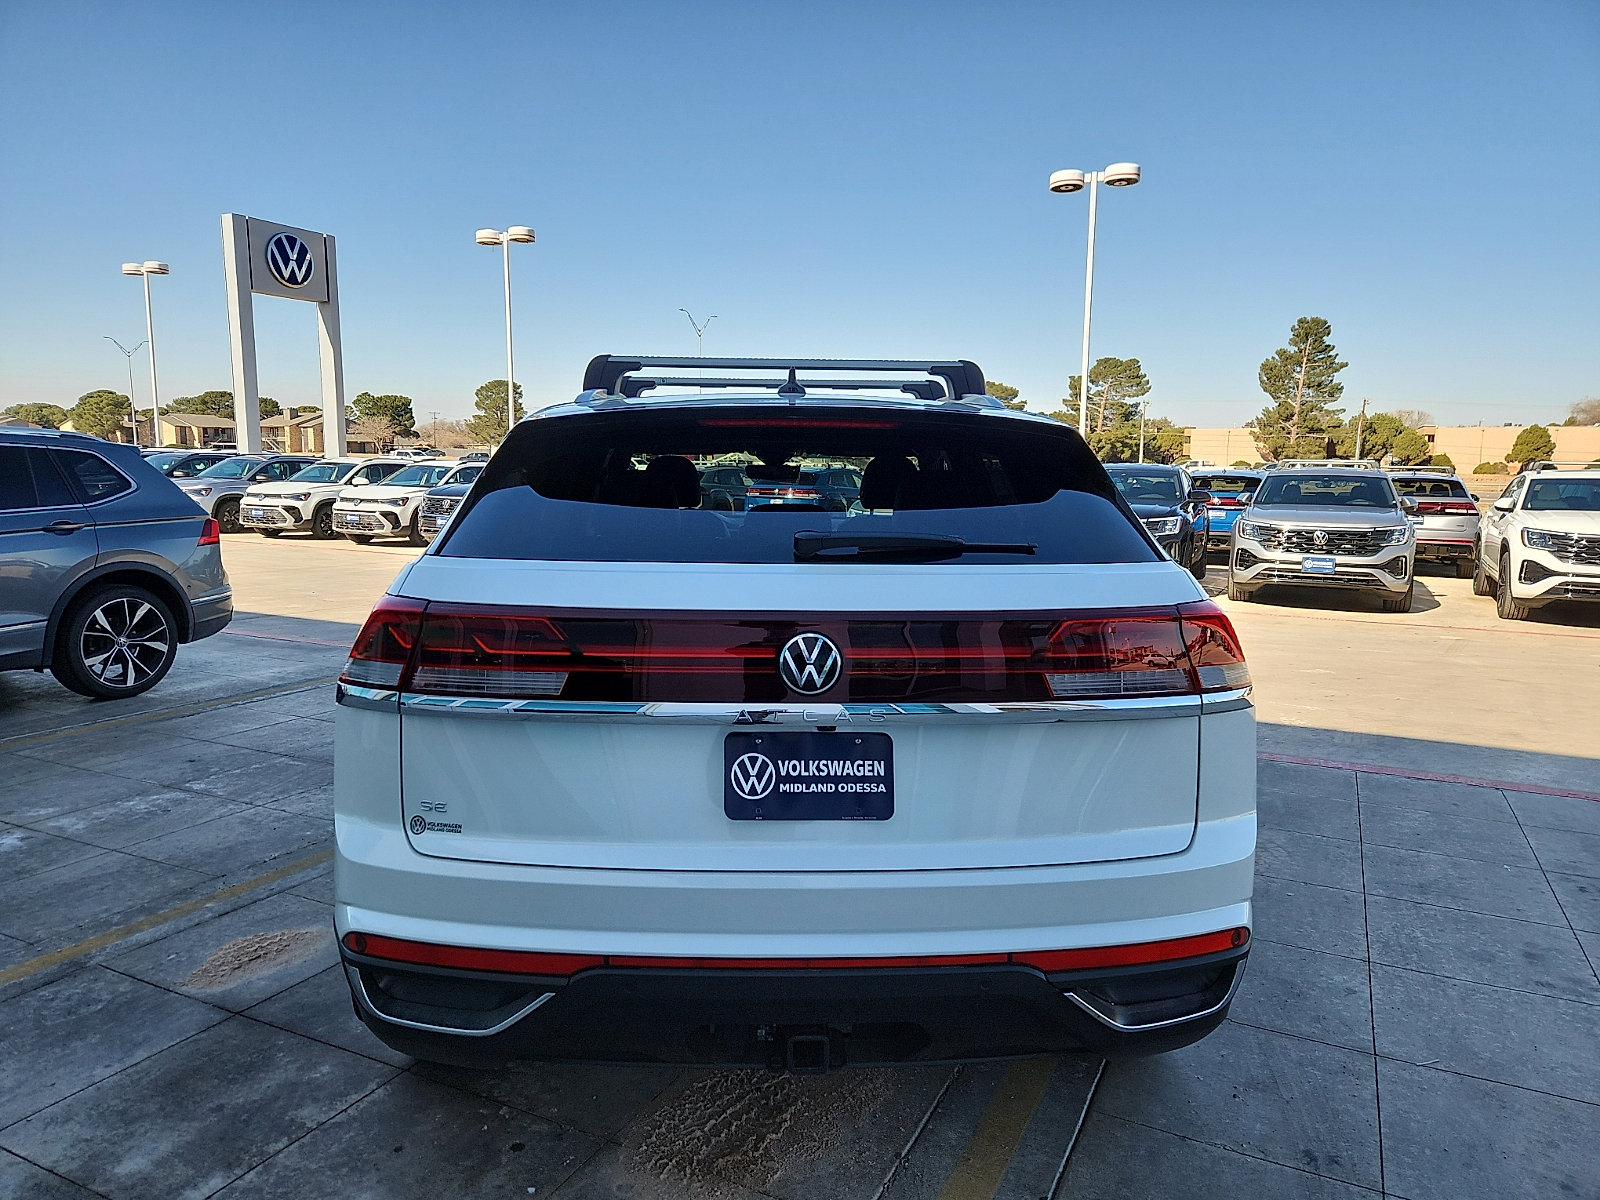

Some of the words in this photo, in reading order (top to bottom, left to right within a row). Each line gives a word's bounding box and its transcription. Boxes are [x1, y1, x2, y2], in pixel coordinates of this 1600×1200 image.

[267, 232, 314, 289] VW
[779, 632, 842, 695] VW
[734, 708, 886, 723] ATLAS
[731, 752, 776, 800] VW
[777, 759, 885, 777] VOLKSWAGEN
[779, 783, 835, 793] MIDLAND
[837, 783, 887, 793] ODESSA
[420, 799, 447, 813] SE
[427, 821, 462, 829] VOLKSWAGEN
